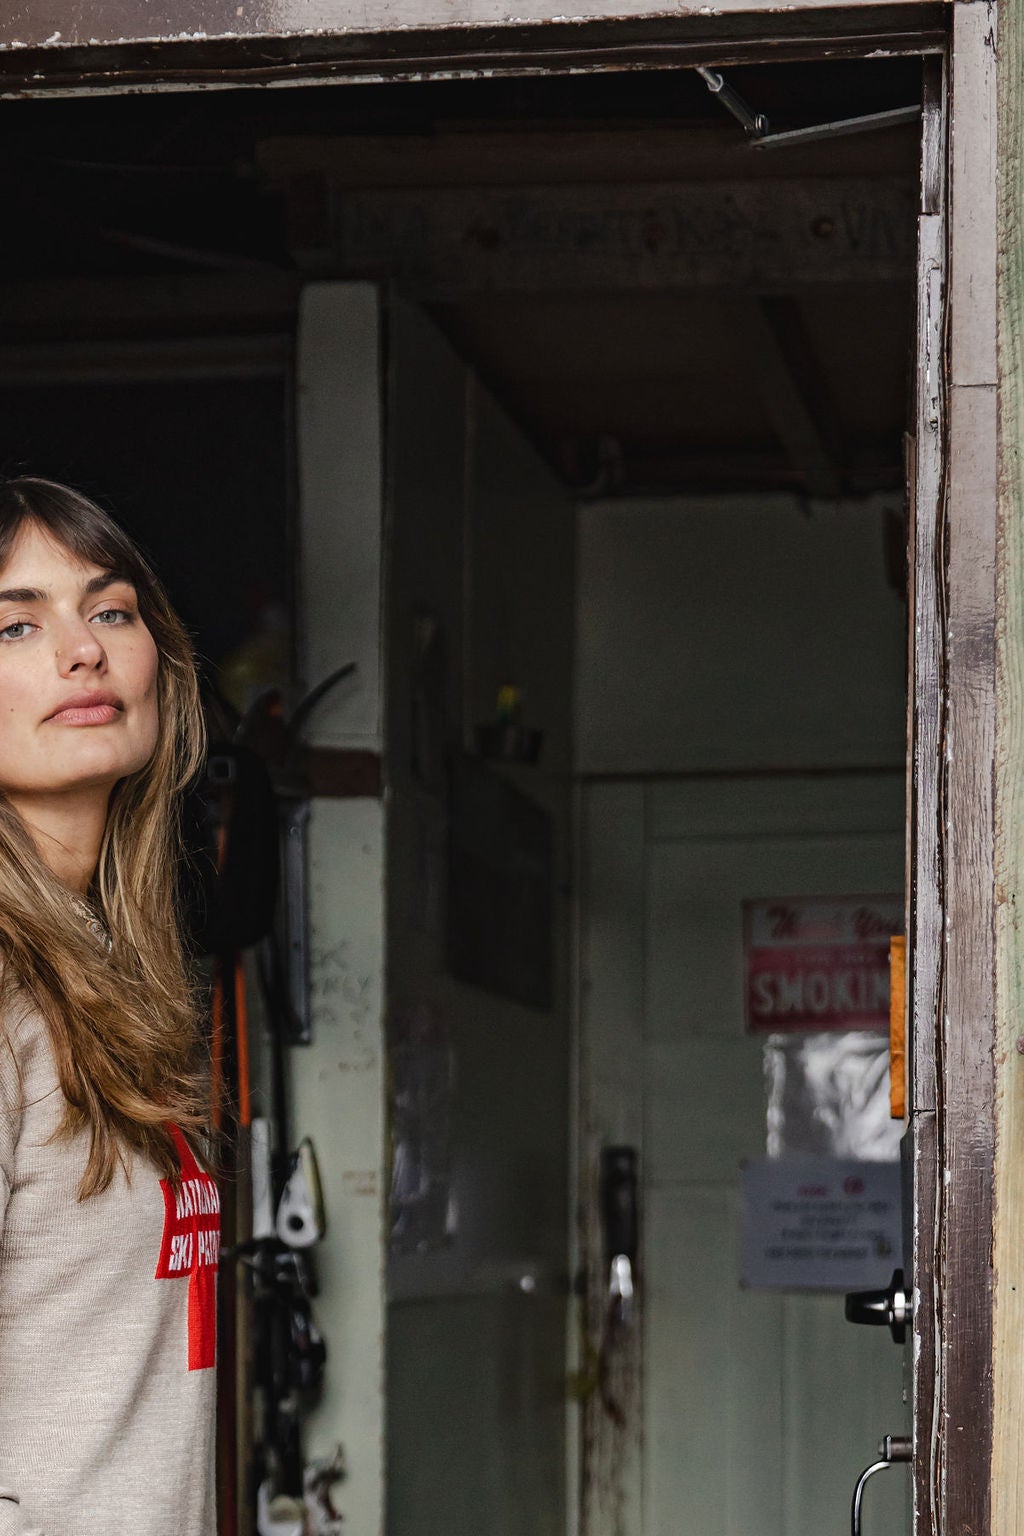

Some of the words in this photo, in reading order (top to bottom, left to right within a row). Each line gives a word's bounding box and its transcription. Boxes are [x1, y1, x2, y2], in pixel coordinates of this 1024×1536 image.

[754, 969, 890, 1016] SMOKIN
[177, 1179, 220, 1220] NATIONA
[168, 1233, 193, 1270] SKI
